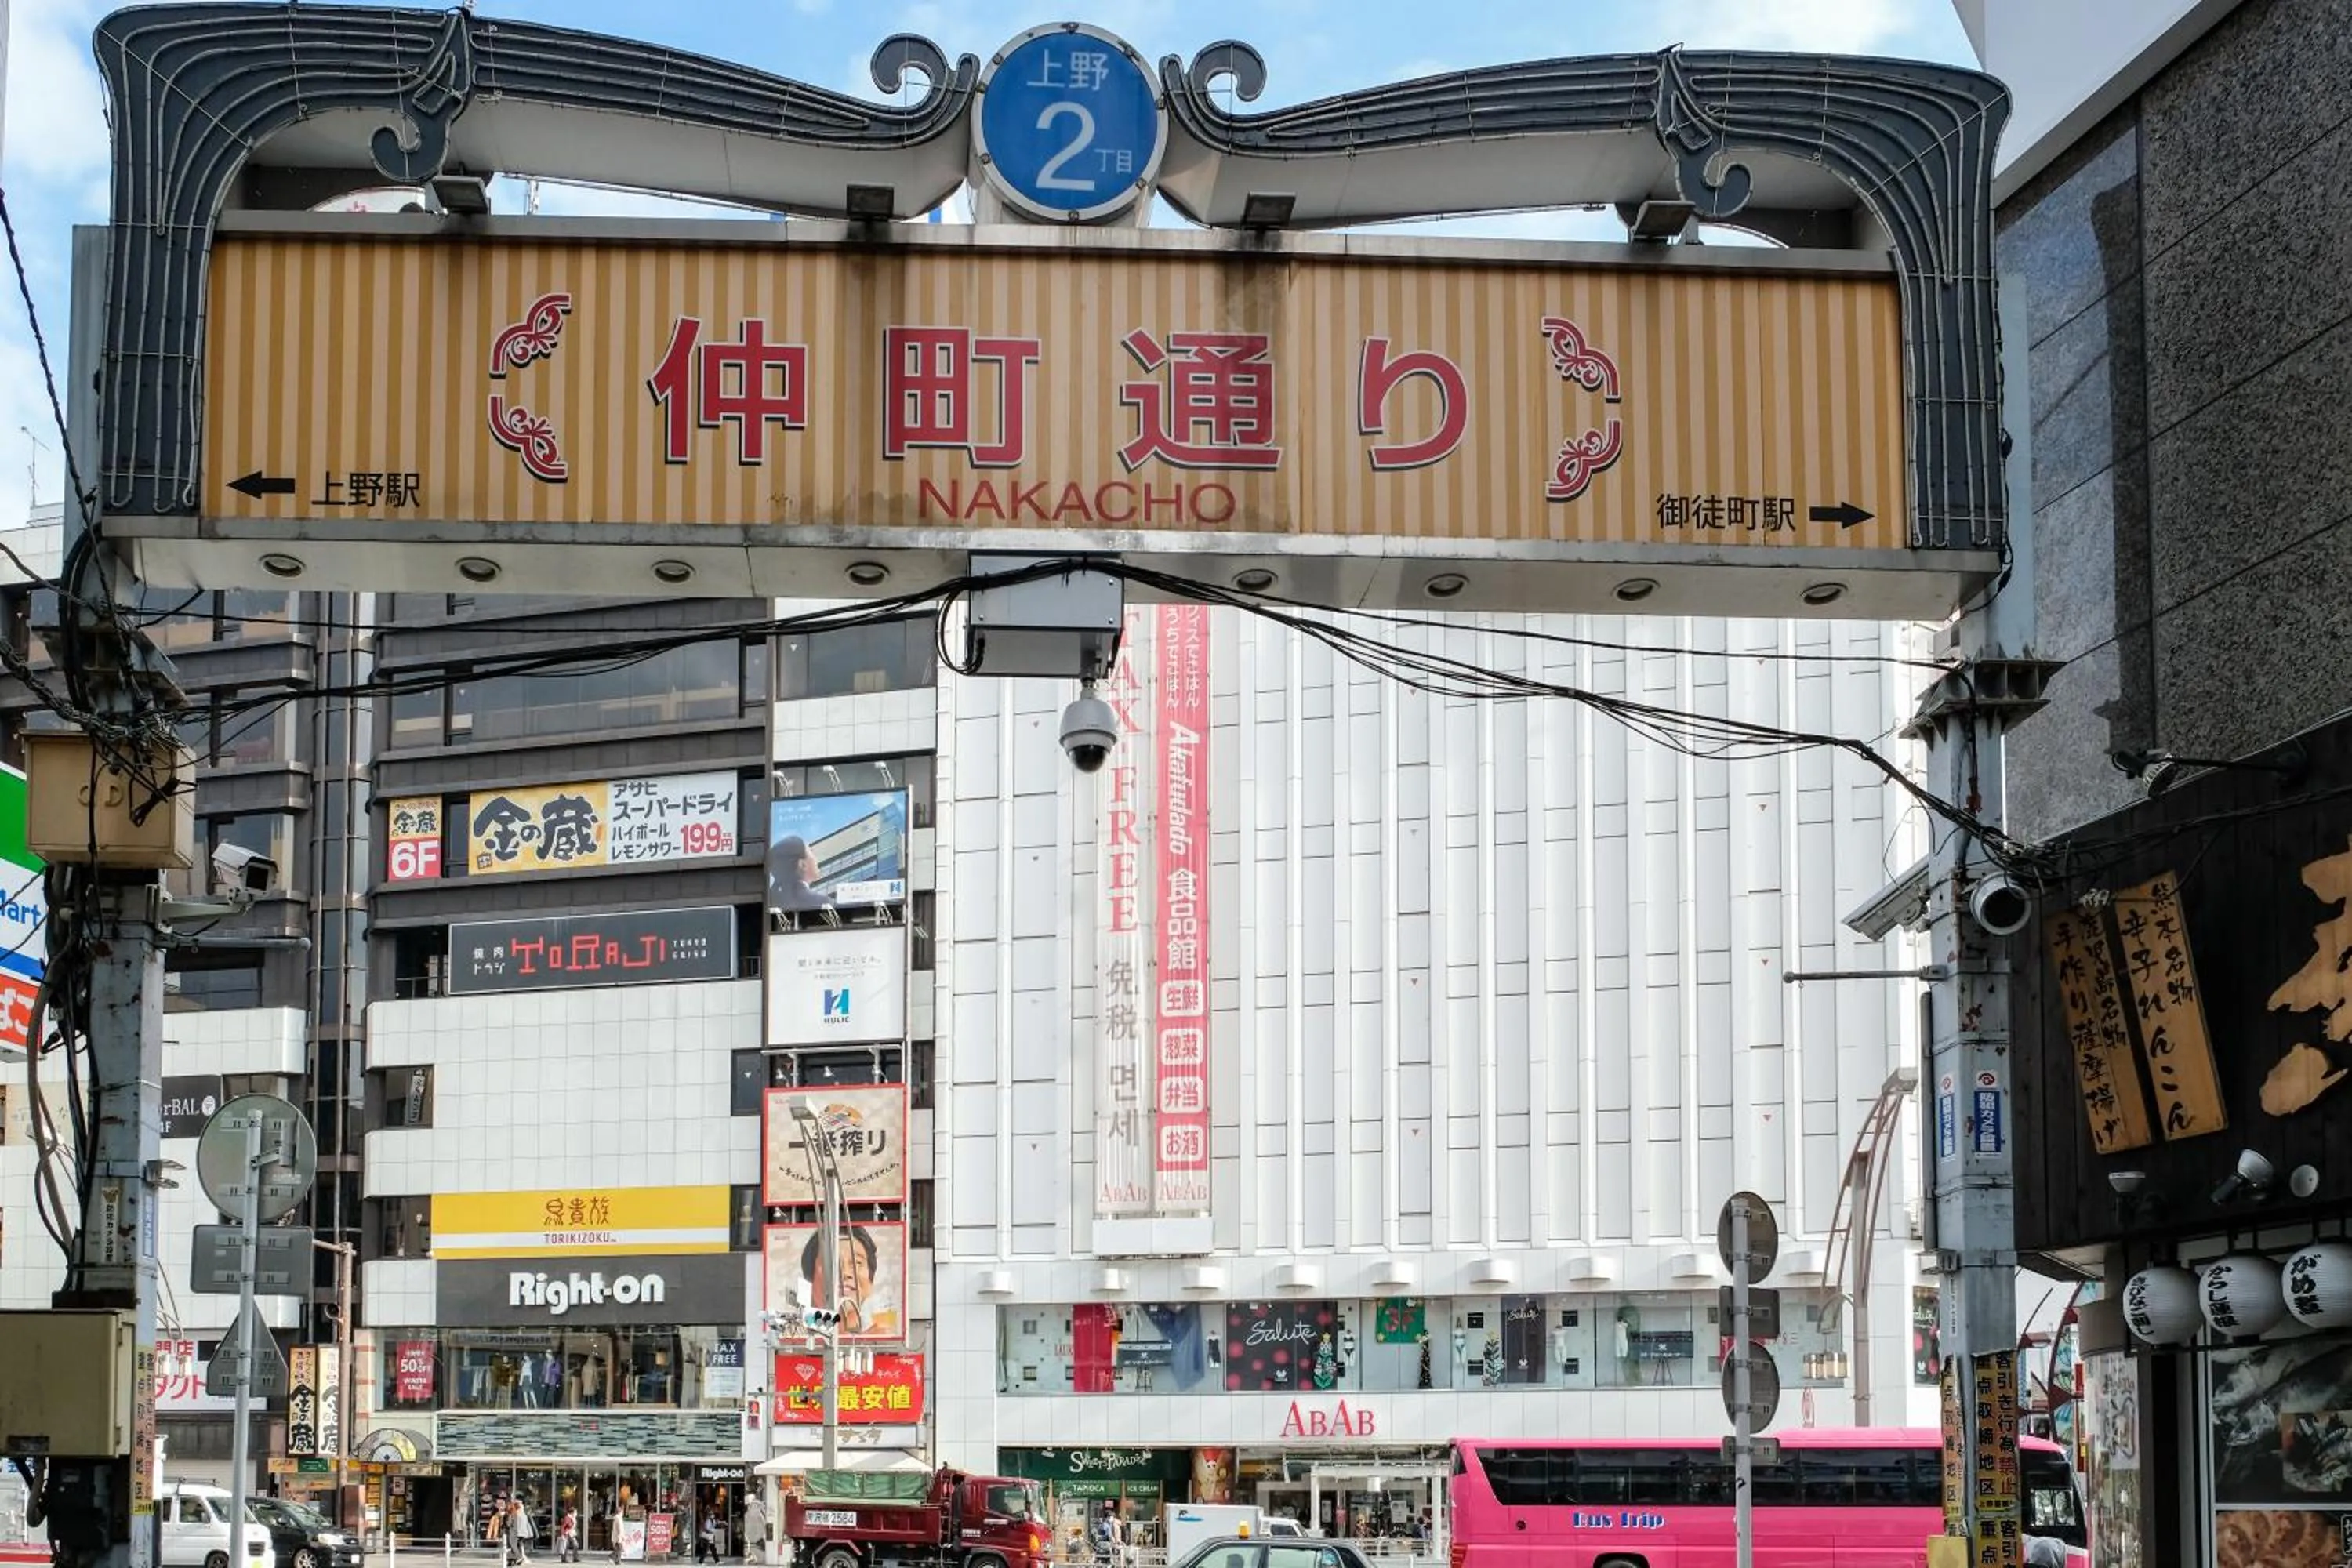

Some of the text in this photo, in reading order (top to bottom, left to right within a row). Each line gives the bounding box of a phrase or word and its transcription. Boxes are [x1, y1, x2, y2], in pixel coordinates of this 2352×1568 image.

[1027, 49, 1109, 91] 上野
[647, 316, 1468, 472] 仲町通り
[311, 471, 421, 508] 上野駅
[918, 478, 1236, 524] NAKACHO
[1656, 493, 1795, 532] 御徒町駅
[614, 782, 658, 798] アサヒ
[612, 792, 733, 822] スーパードライ
[473, 793, 600, 862] 金の蔵
[612, 822, 670, 840] ハイボール
[392, 840, 439, 879] 6F
[612, 841, 681, 860] レモンサワー
[1167, 867, 1199, 971] 食品館
[474, 963, 506, 975] トラジ
[1166, 987, 1199, 1011] 生鮮
[1107, 1063, 1139, 1147] 면세
[1165, 1083, 1199, 1108] 弁当
[1165, 1131, 1199, 1156] お酒
[544, 1232, 610, 1244] TORIKIZOKU
[509, 1271, 665, 1316] Right-on
[1246, 1317, 1317, 1346] Salute
[713, 1354, 738, 1364] FREE
[714, 1343, 737, 1353] TAX
[1573, 1512, 1664, 1530] Bus Trip
